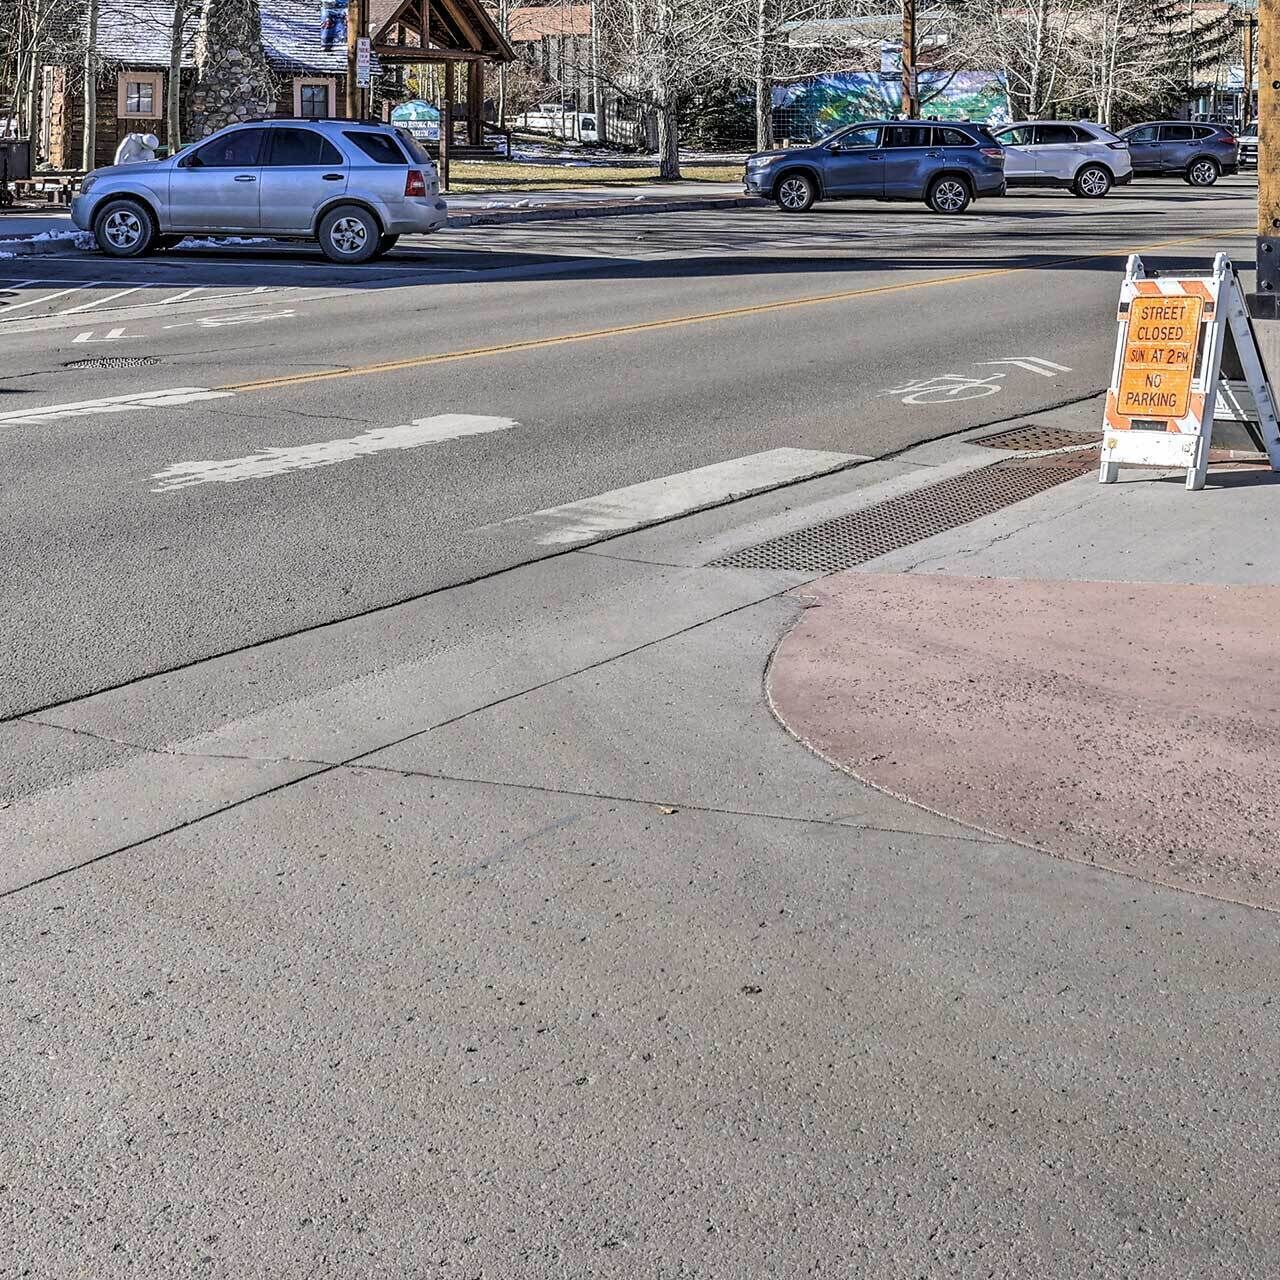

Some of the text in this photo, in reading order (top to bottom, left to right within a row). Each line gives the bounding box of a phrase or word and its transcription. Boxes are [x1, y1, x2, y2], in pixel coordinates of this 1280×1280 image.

[1141, 306, 1186, 320] STREET
[1137, 326, 1183, 341] CLOSED
[1130, 349, 1145, 363] SUN
[1151, 349, 1164, 362] AT
[1145, 374, 1161, 388] NO
[1126, 392, 1177, 407] PARKING
